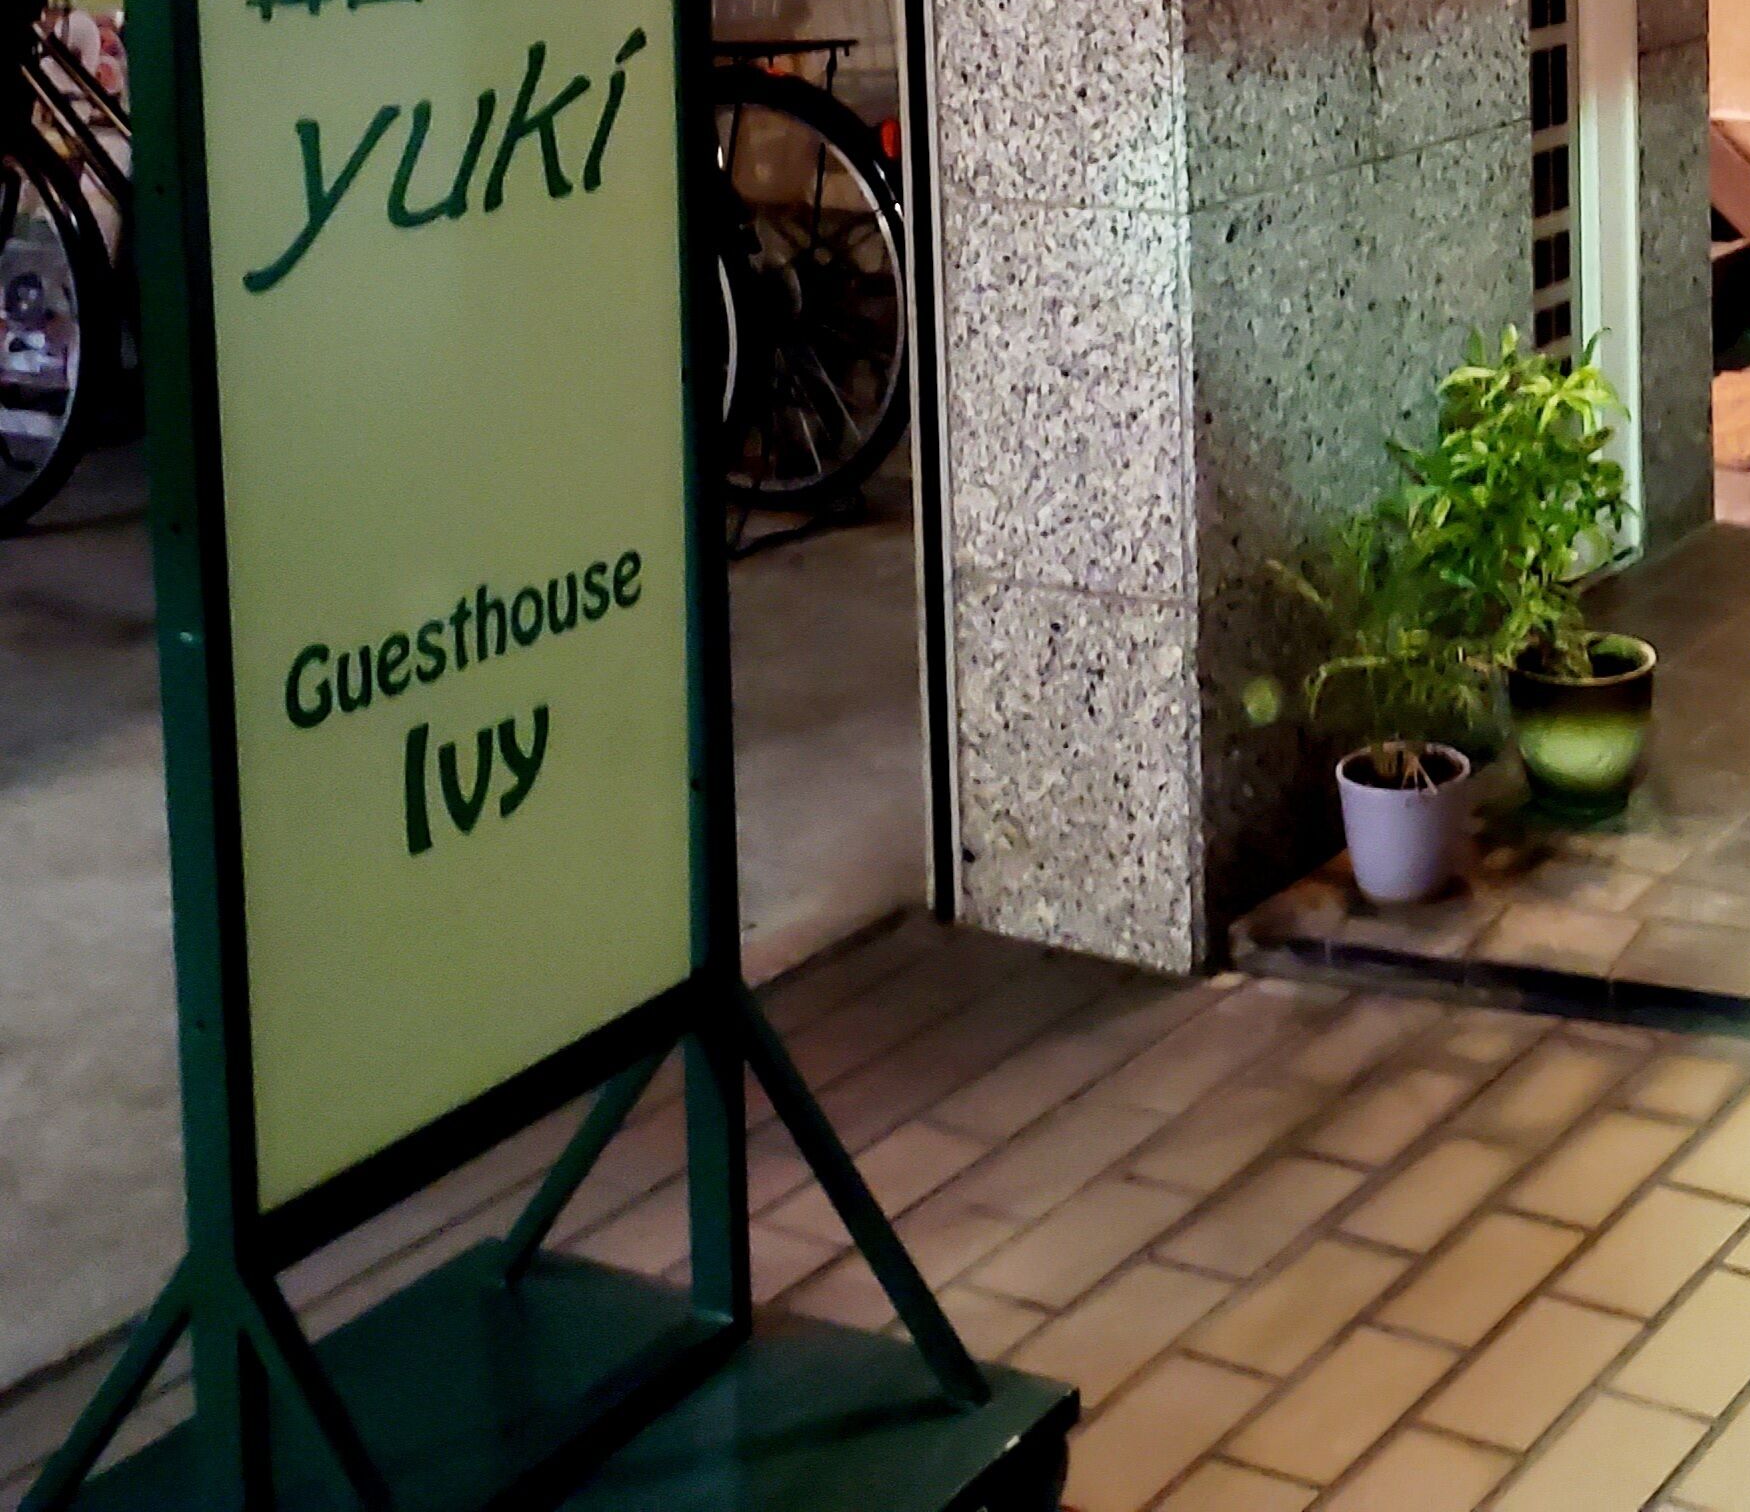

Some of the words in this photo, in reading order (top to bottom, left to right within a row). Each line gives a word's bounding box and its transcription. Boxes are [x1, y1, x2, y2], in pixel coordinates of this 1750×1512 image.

[243, 27, 648, 294] yuki
[284, 548, 643, 730] Guesthouse
[403, 703, 550, 857] Ivy
